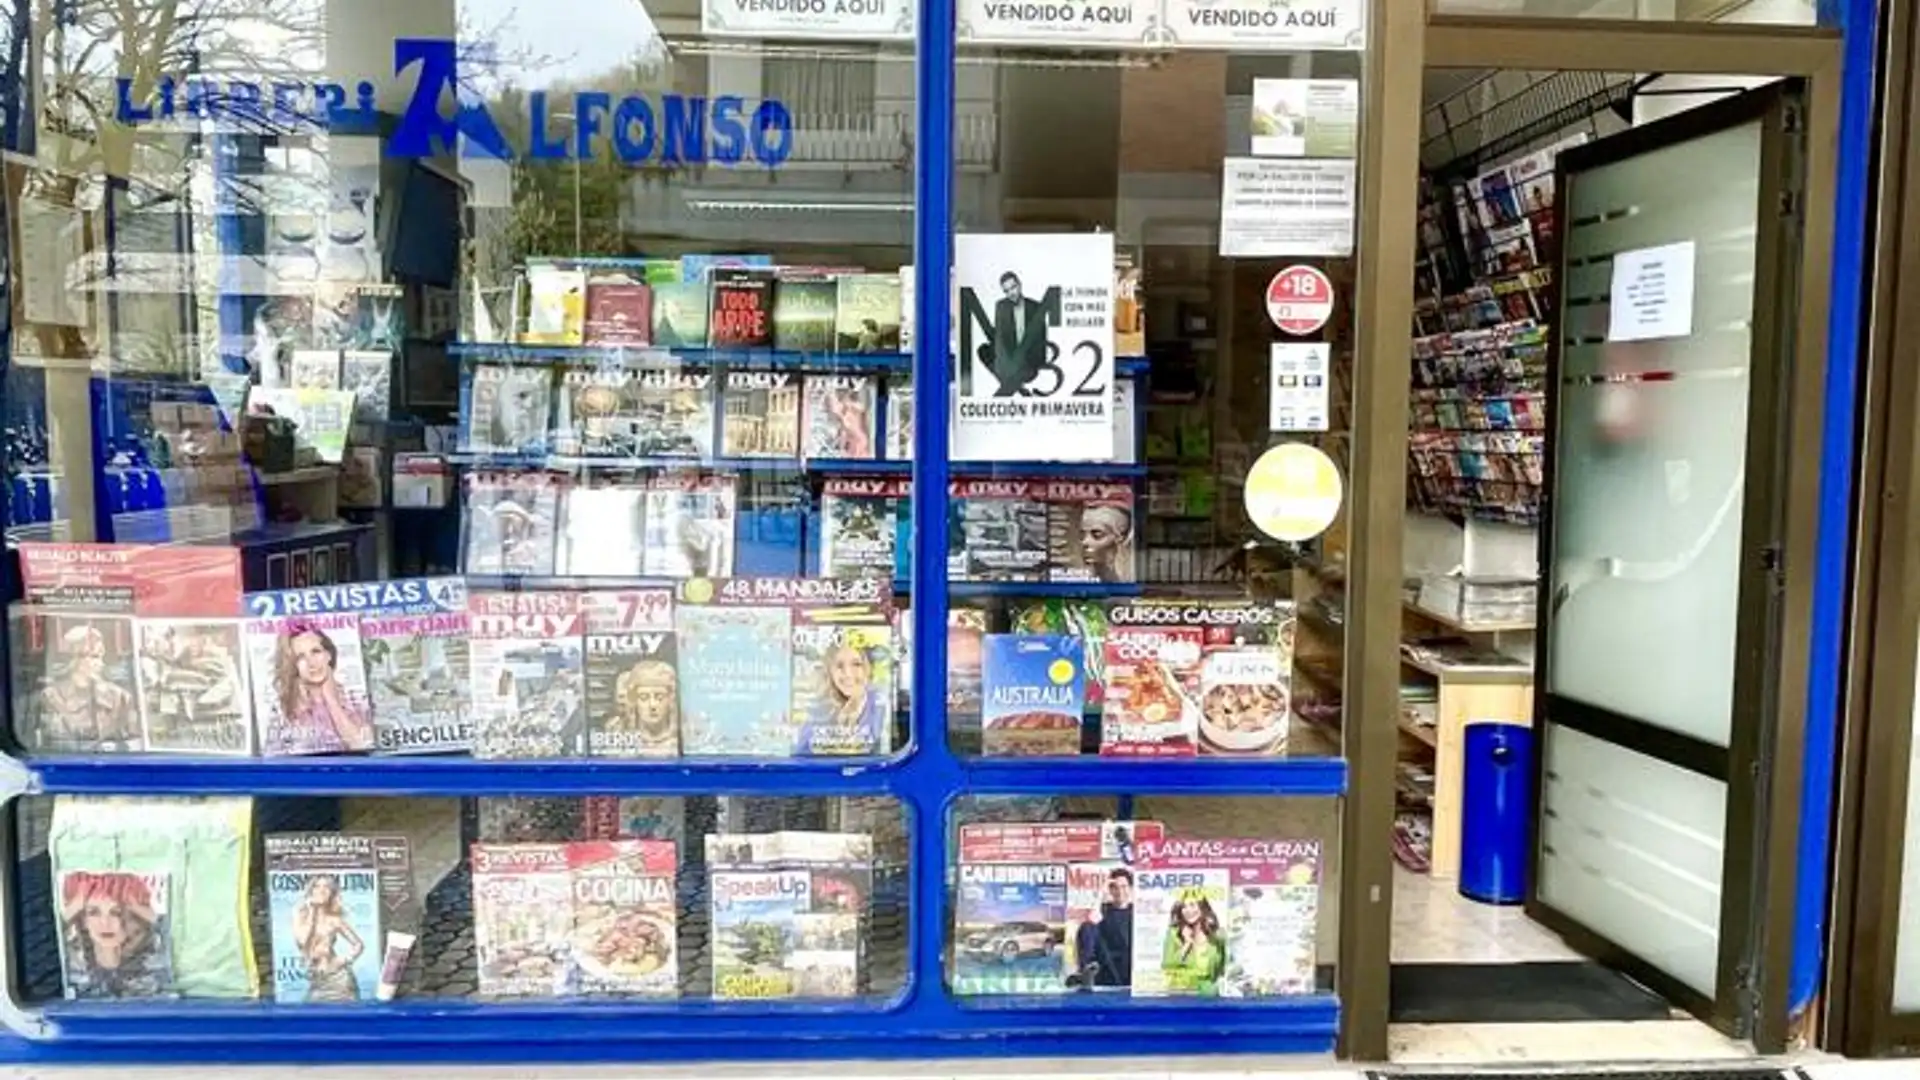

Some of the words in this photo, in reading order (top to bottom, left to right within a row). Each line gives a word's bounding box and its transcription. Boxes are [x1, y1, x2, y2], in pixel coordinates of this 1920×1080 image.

[735, 0, 824, 14] VENDIDO
[984, 3, 1074, 21] VENDIDO
[1188, 8, 1278, 27] VENDIDO
[1285, 7, 1338, 28] AQUÍ
[1281, 274, 1318, 297] +18
[720, 292, 760, 310] TODO
[714, 309, 766, 337] ARDE
[728, 371, 791, 390] muy
[807, 376, 868, 391] muy
[959, 399, 1027, 417] COLECCIÓN
[1031, 400, 1105, 417] PRIMAVERA
[824, 479, 888, 495] muy
[721, 579, 751, 598] 48
[251, 596, 275, 619] 2
[285, 581, 421, 615] REVISTAS
[1111, 606, 1182, 624] GUISOS
[1183, 607, 1274, 625] CASEROS
[471, 613, 578, 641] muy
[587, 634, 664, 655] muy
[992, 684, 1075, 706] AUSTRALIA
[1137, 840, 1222, 858] PLANTAS
[1250, 841, 1321, 857] CURAN
[476, 852, 492, 872] 3
[575, 878, 671, 903] COCINA
[1137, 873, 1206, 889] SABER
